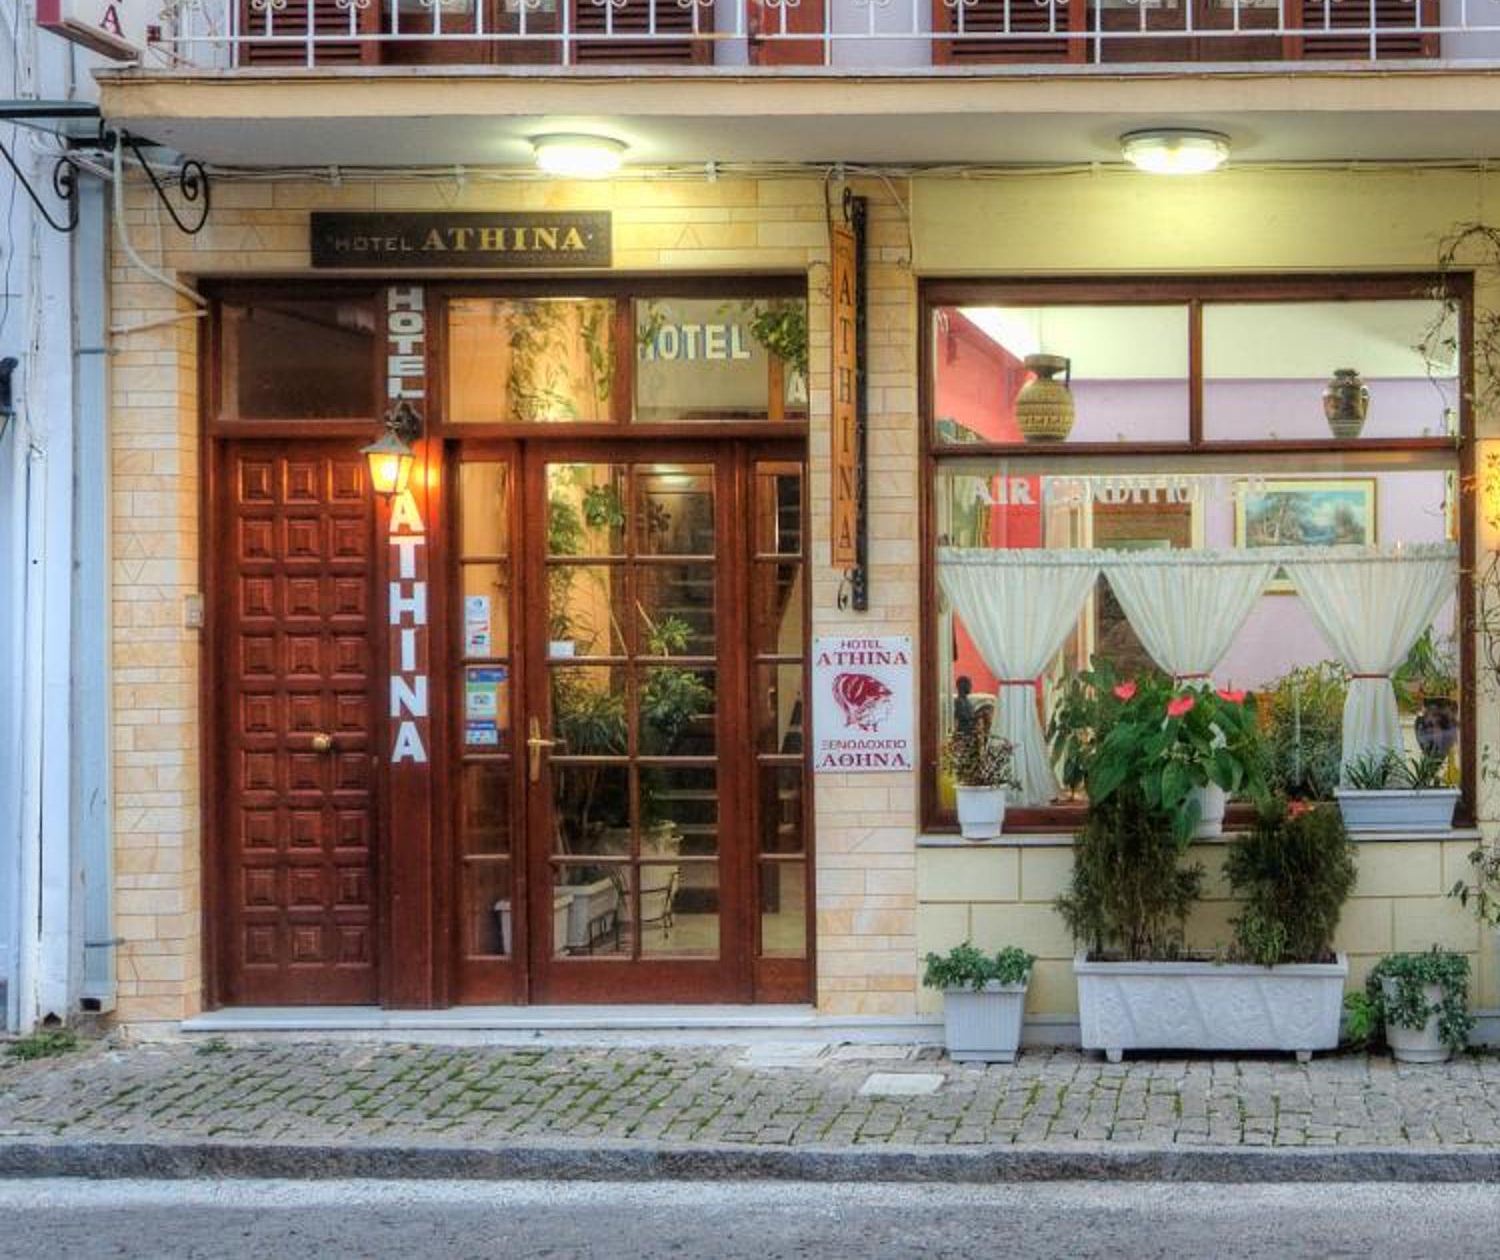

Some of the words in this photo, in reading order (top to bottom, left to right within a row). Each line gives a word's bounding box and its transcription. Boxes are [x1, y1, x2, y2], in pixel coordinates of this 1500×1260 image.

[421, 227, 587, 251] ATHINA
[387, 287, 426, 400] HOTEL
[838, 274, 851, 549] ATHINA
[972, 477, 1036, 504] AIR
[389, 487, 427, 762] ATHINA
[840, 639, 882, 649] HOTEL
[817, 651, 908, 666] ATHINA
[821, 752, 906, 767] ΑΘΗΝΑ
